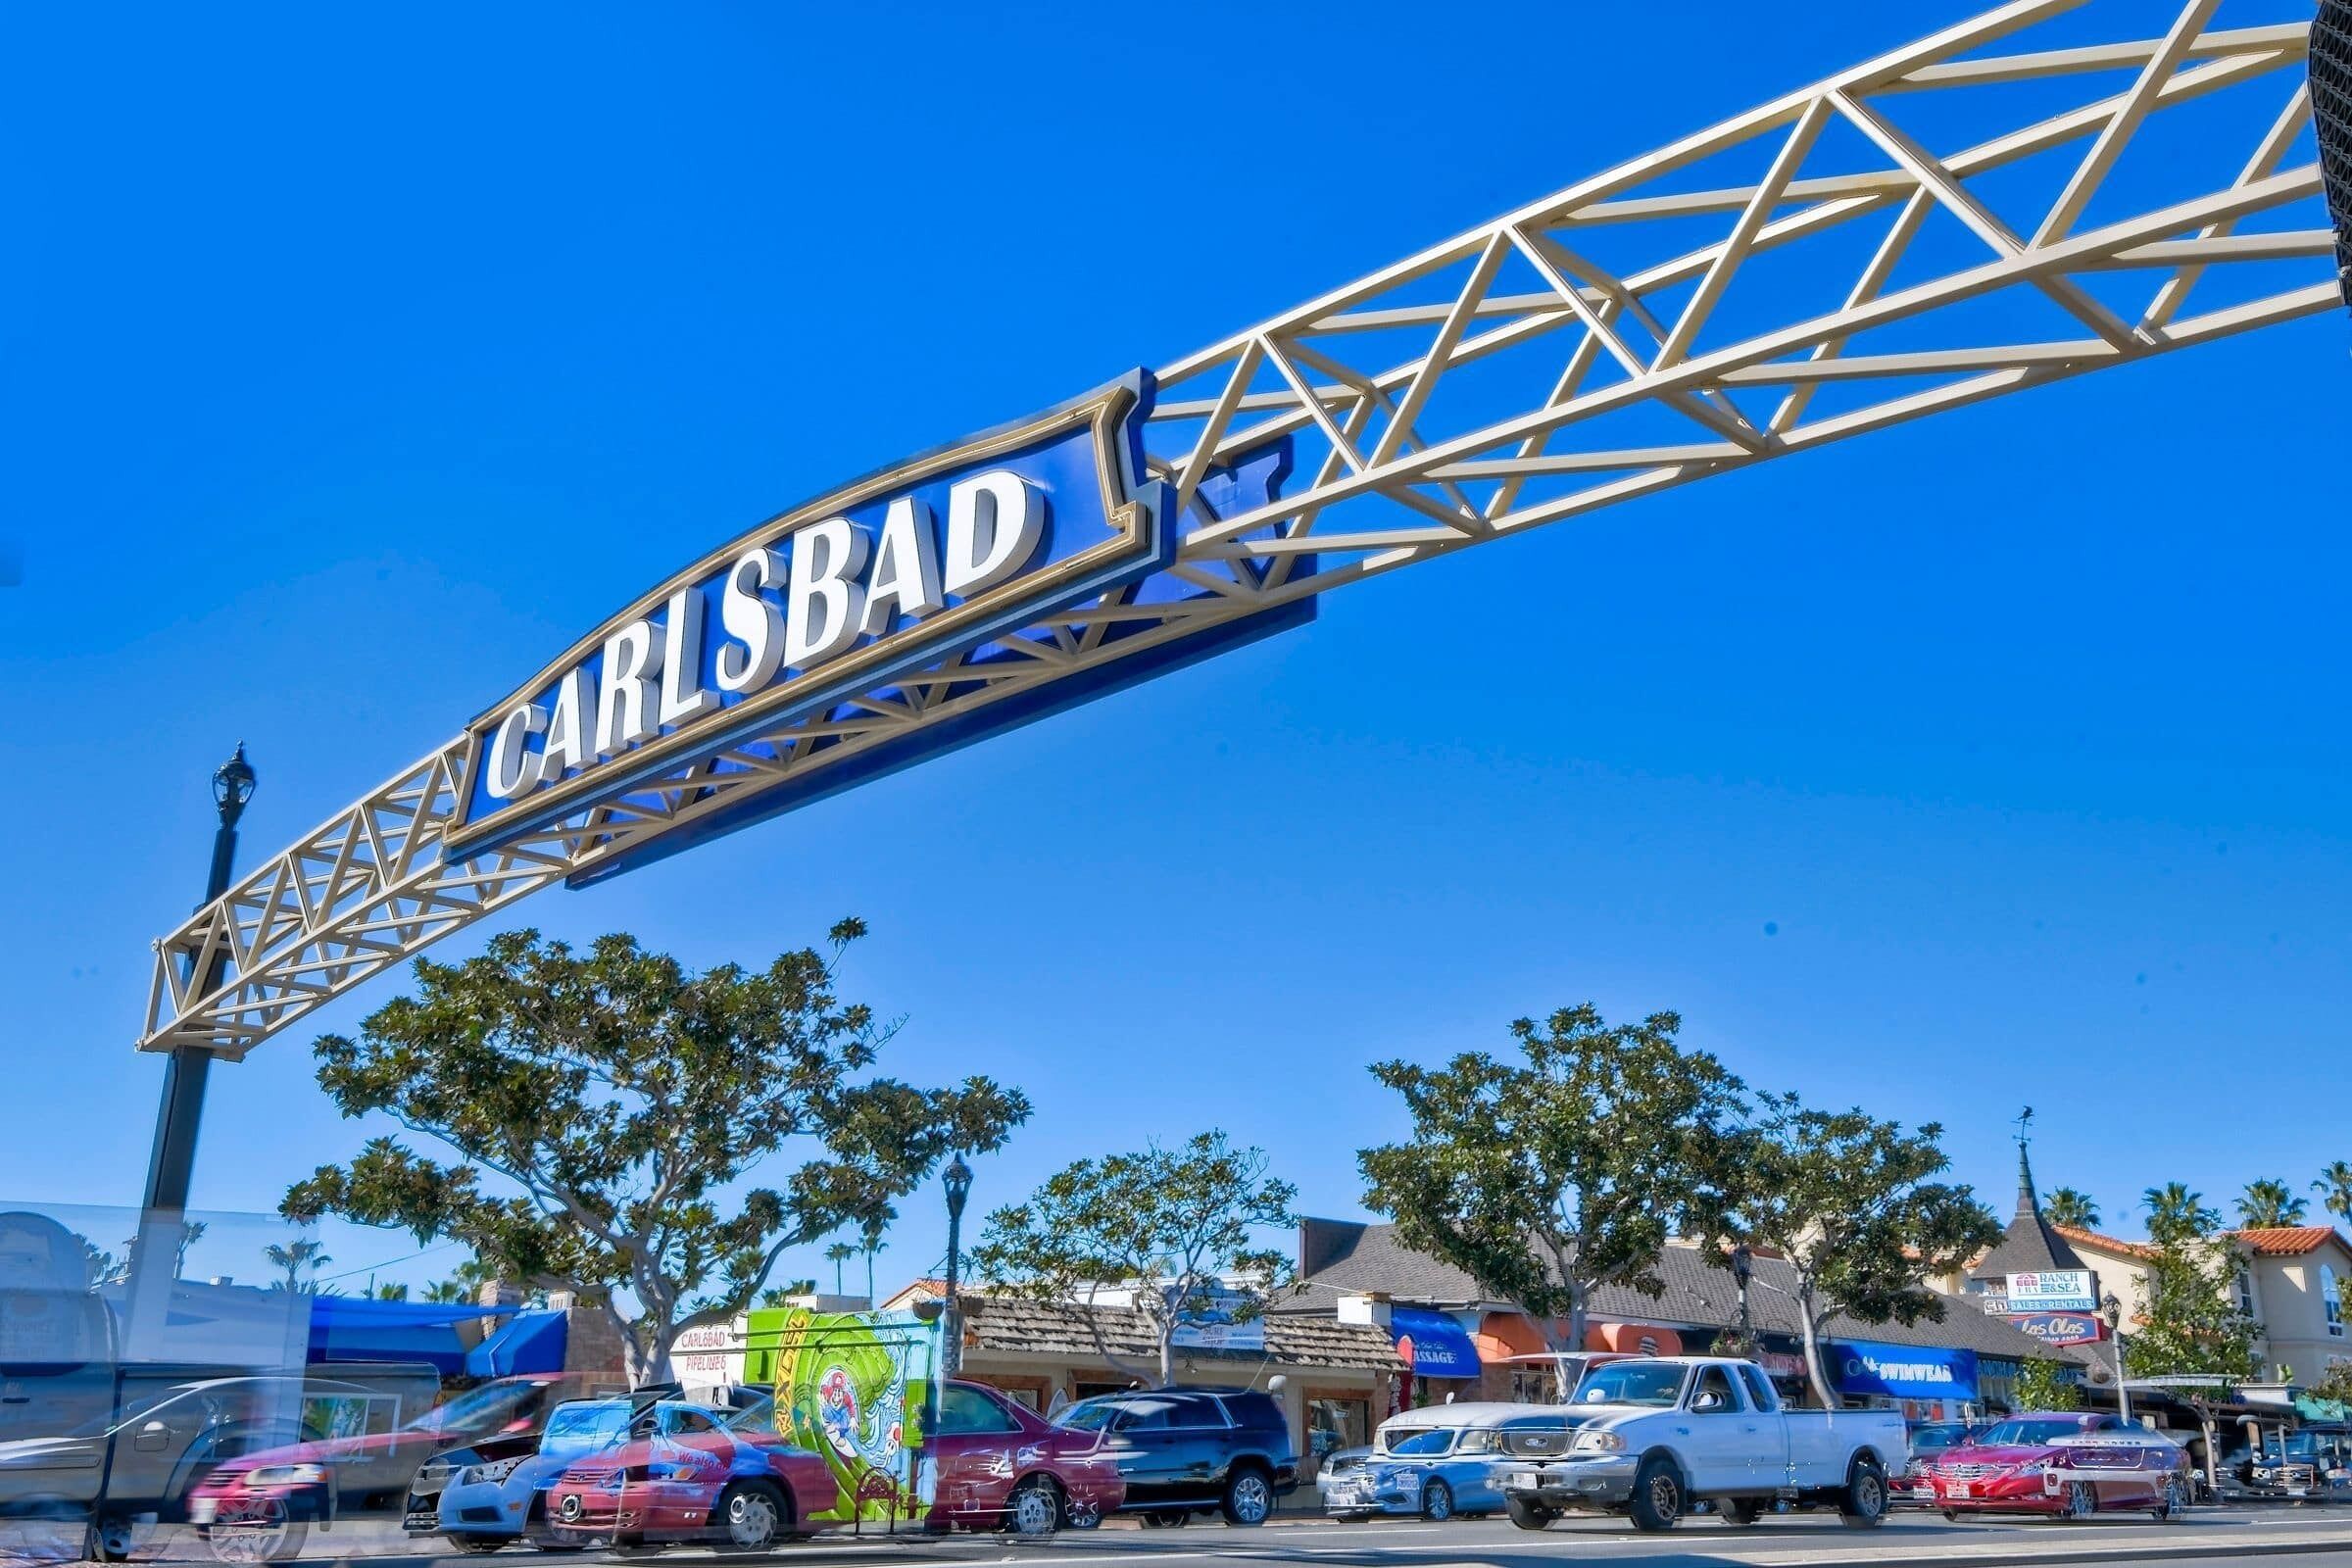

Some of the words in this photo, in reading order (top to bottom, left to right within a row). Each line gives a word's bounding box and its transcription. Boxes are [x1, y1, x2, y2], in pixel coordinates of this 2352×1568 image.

[487, 469, 1044, 801] CARLSBAD
[2039, 1272, 2078, 1283] RANCH
[2010, 1300, 2040, 1310] SALES
[2049, 1299, 2093, 1310] RENTALS
[2021, 1319, 2047, 1335] Las
[2048, 1317, 2085, 1335] Olas
[681, 1332, 725, 1348] CARLSBAD
[685, 1355, 727, 1371] PIPELINES
[1413, 1349, 1455, 1364] ASSAGE
[678, 1450, 693, 1463] We
[695, 1455, 714, 1468] also
